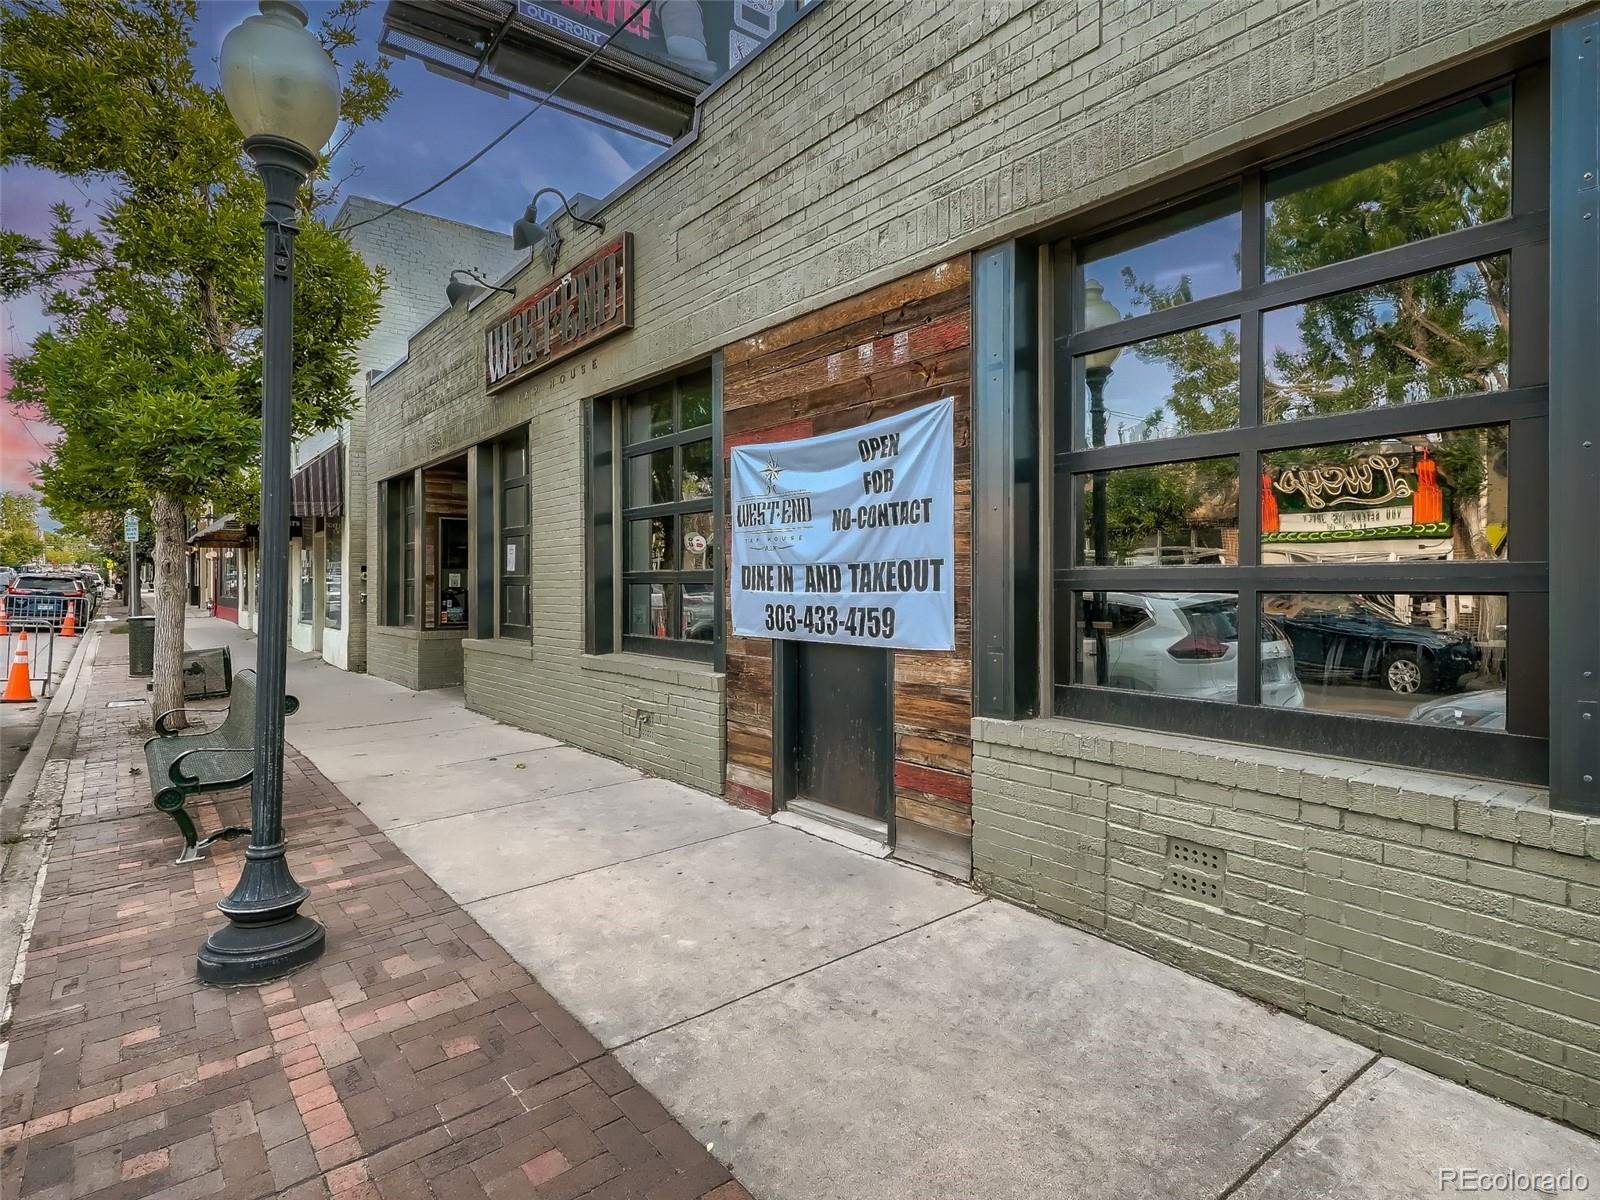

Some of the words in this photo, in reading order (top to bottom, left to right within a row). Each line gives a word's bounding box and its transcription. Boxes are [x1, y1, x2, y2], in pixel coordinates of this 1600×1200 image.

[527, 5, 602, 44] OUTFRONT
[561, 253, 617, 346] END
[549, 358, 598, 389] HOUSE
[857, 432, 901, 463] OPEN
[863, 468, 894, 495] FOR
[832, 498, 933, 532] NO-CONTACT
[741, 565, 774, 592] DINE
[777, 565, 794, 593] IN
[804, 564, 843, 593] AND
[848, 558, 944, 593] TAKEOUT
[765, 603, 896, 639] 303-433-4759
